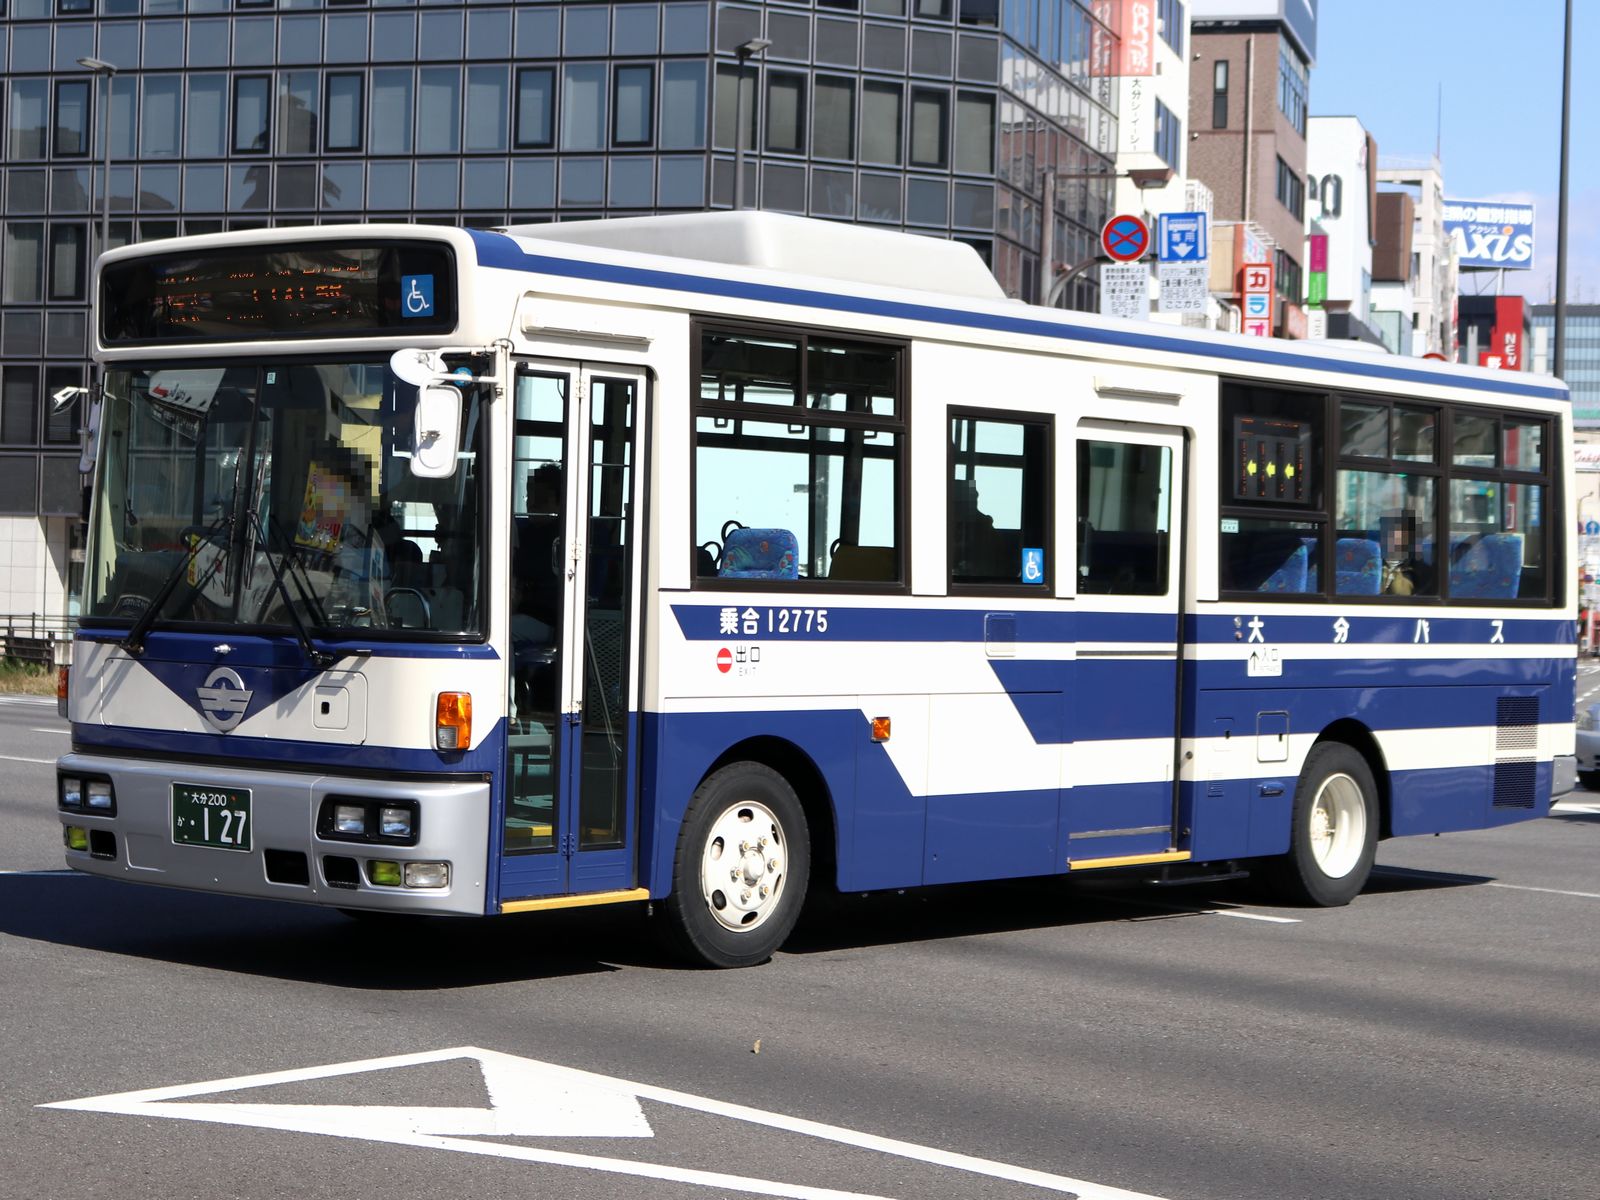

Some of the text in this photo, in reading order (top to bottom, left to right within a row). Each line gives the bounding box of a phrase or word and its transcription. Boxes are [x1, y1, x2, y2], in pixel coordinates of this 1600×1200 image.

[1468, 225, 1499, 234] アクシス
[1165, 300, 1201, 309] ここから
[719, 607, 828, 635] 乗合 12775
[1248, 615, 1504, 644] 大分バス
[735, 645, 760, 663] 出口
[1261, 647, 1278, 662] 入口
